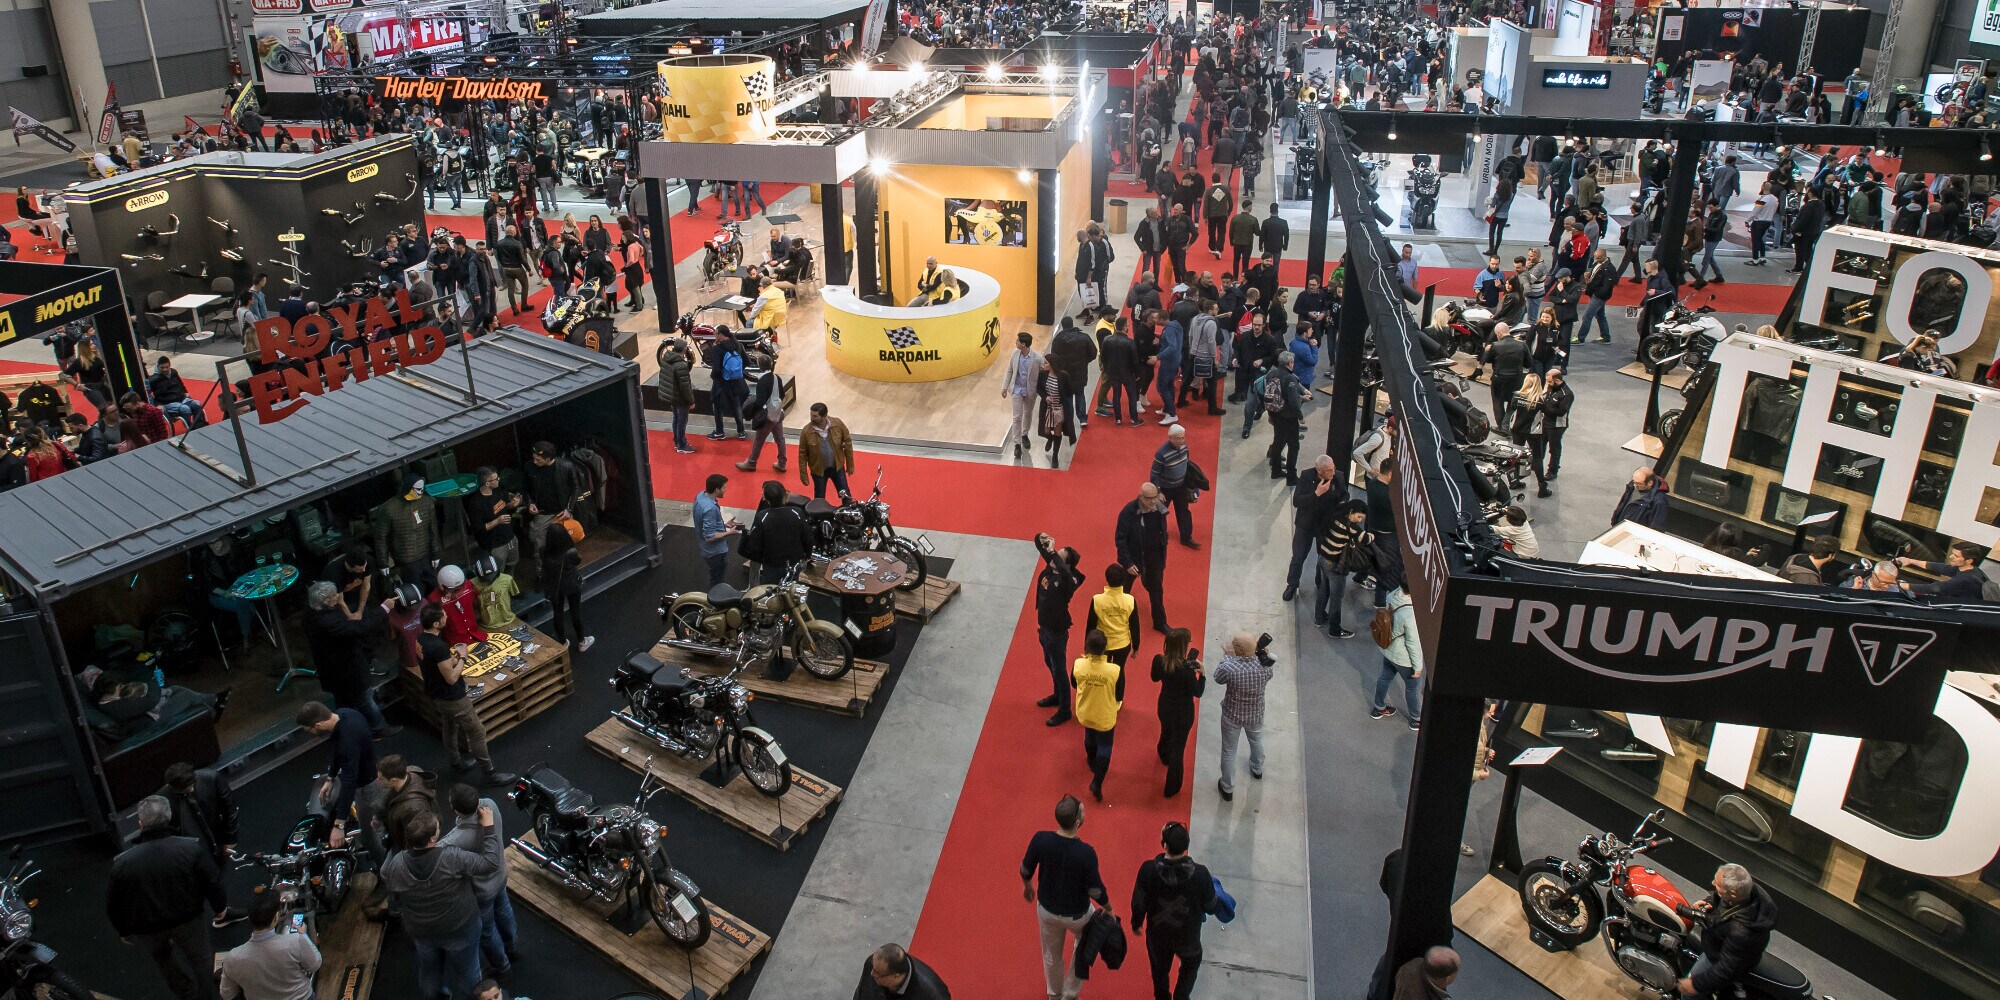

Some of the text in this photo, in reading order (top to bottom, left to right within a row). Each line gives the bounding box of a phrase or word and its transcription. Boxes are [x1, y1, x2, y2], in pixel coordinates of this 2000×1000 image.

[375, 76, 550, 106] Harley-Davidson
[351, 164, 376, 180] ARROW
[129, 191, 166, 209] ARROW
[34, 284, 103, 323] MOTO.IT
[254, 288, 423, 364] ROYAL
[879, 349, 942, 363] BARDAHL
[249, 325, 447, 426] ENFIELD
[1465, 594, 1833, 683] TRIUMPH
